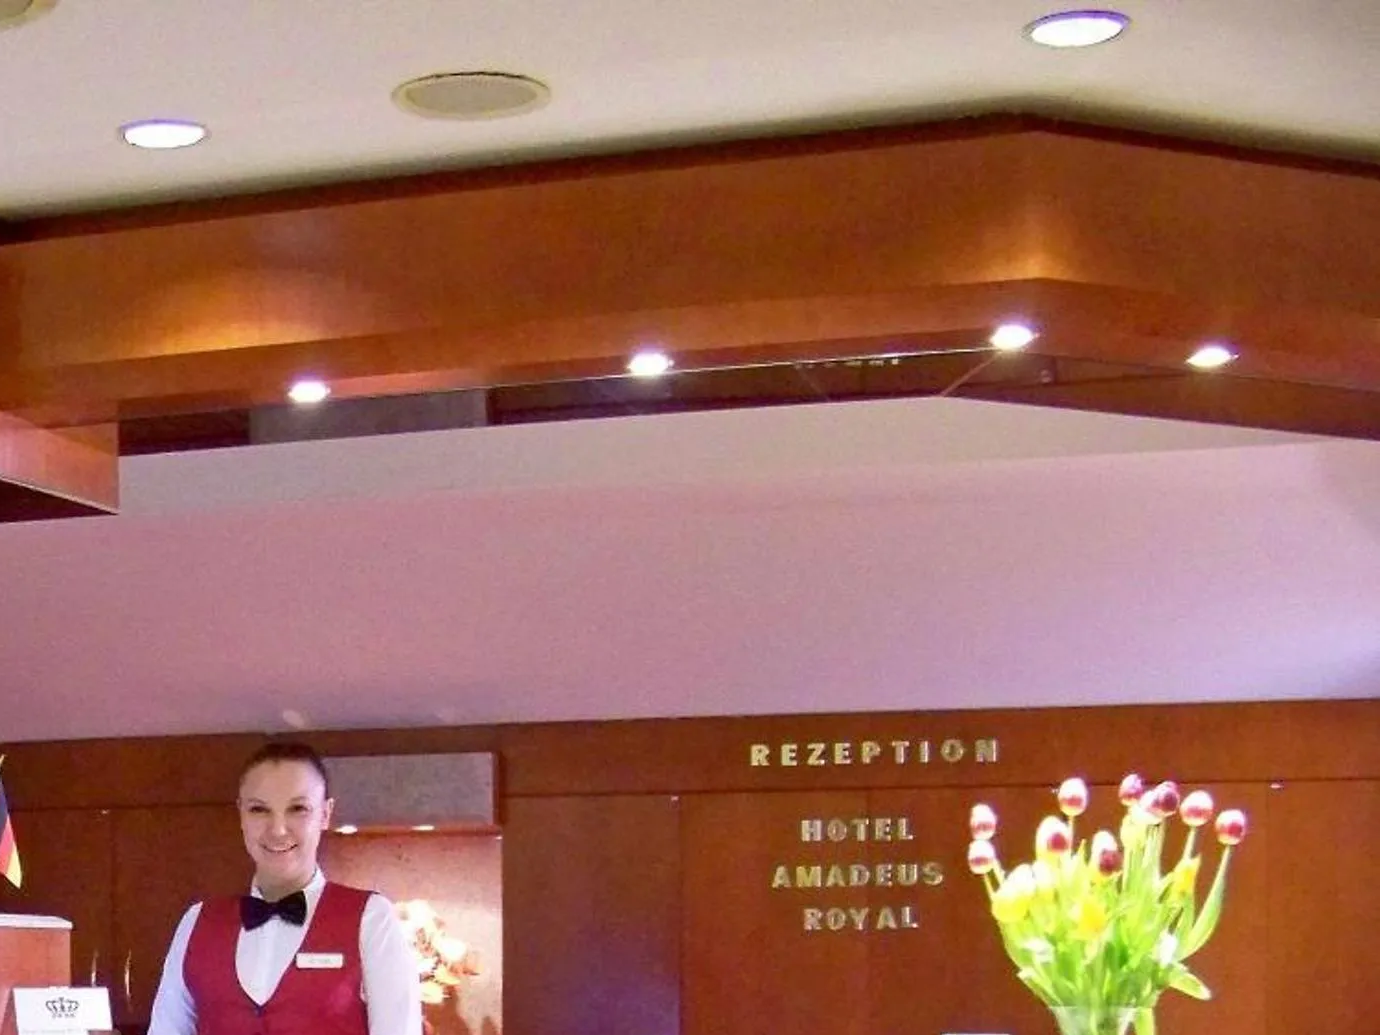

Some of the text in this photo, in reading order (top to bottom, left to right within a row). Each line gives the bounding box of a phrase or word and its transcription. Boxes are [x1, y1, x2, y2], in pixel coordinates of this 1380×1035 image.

[749, 739, 999, 767] REZEPTION
[800, 818, 914, 842] HOTEL
[772, 862, 945, 888] AMADEUS
[803, 906, 920, 931] ROYAL
